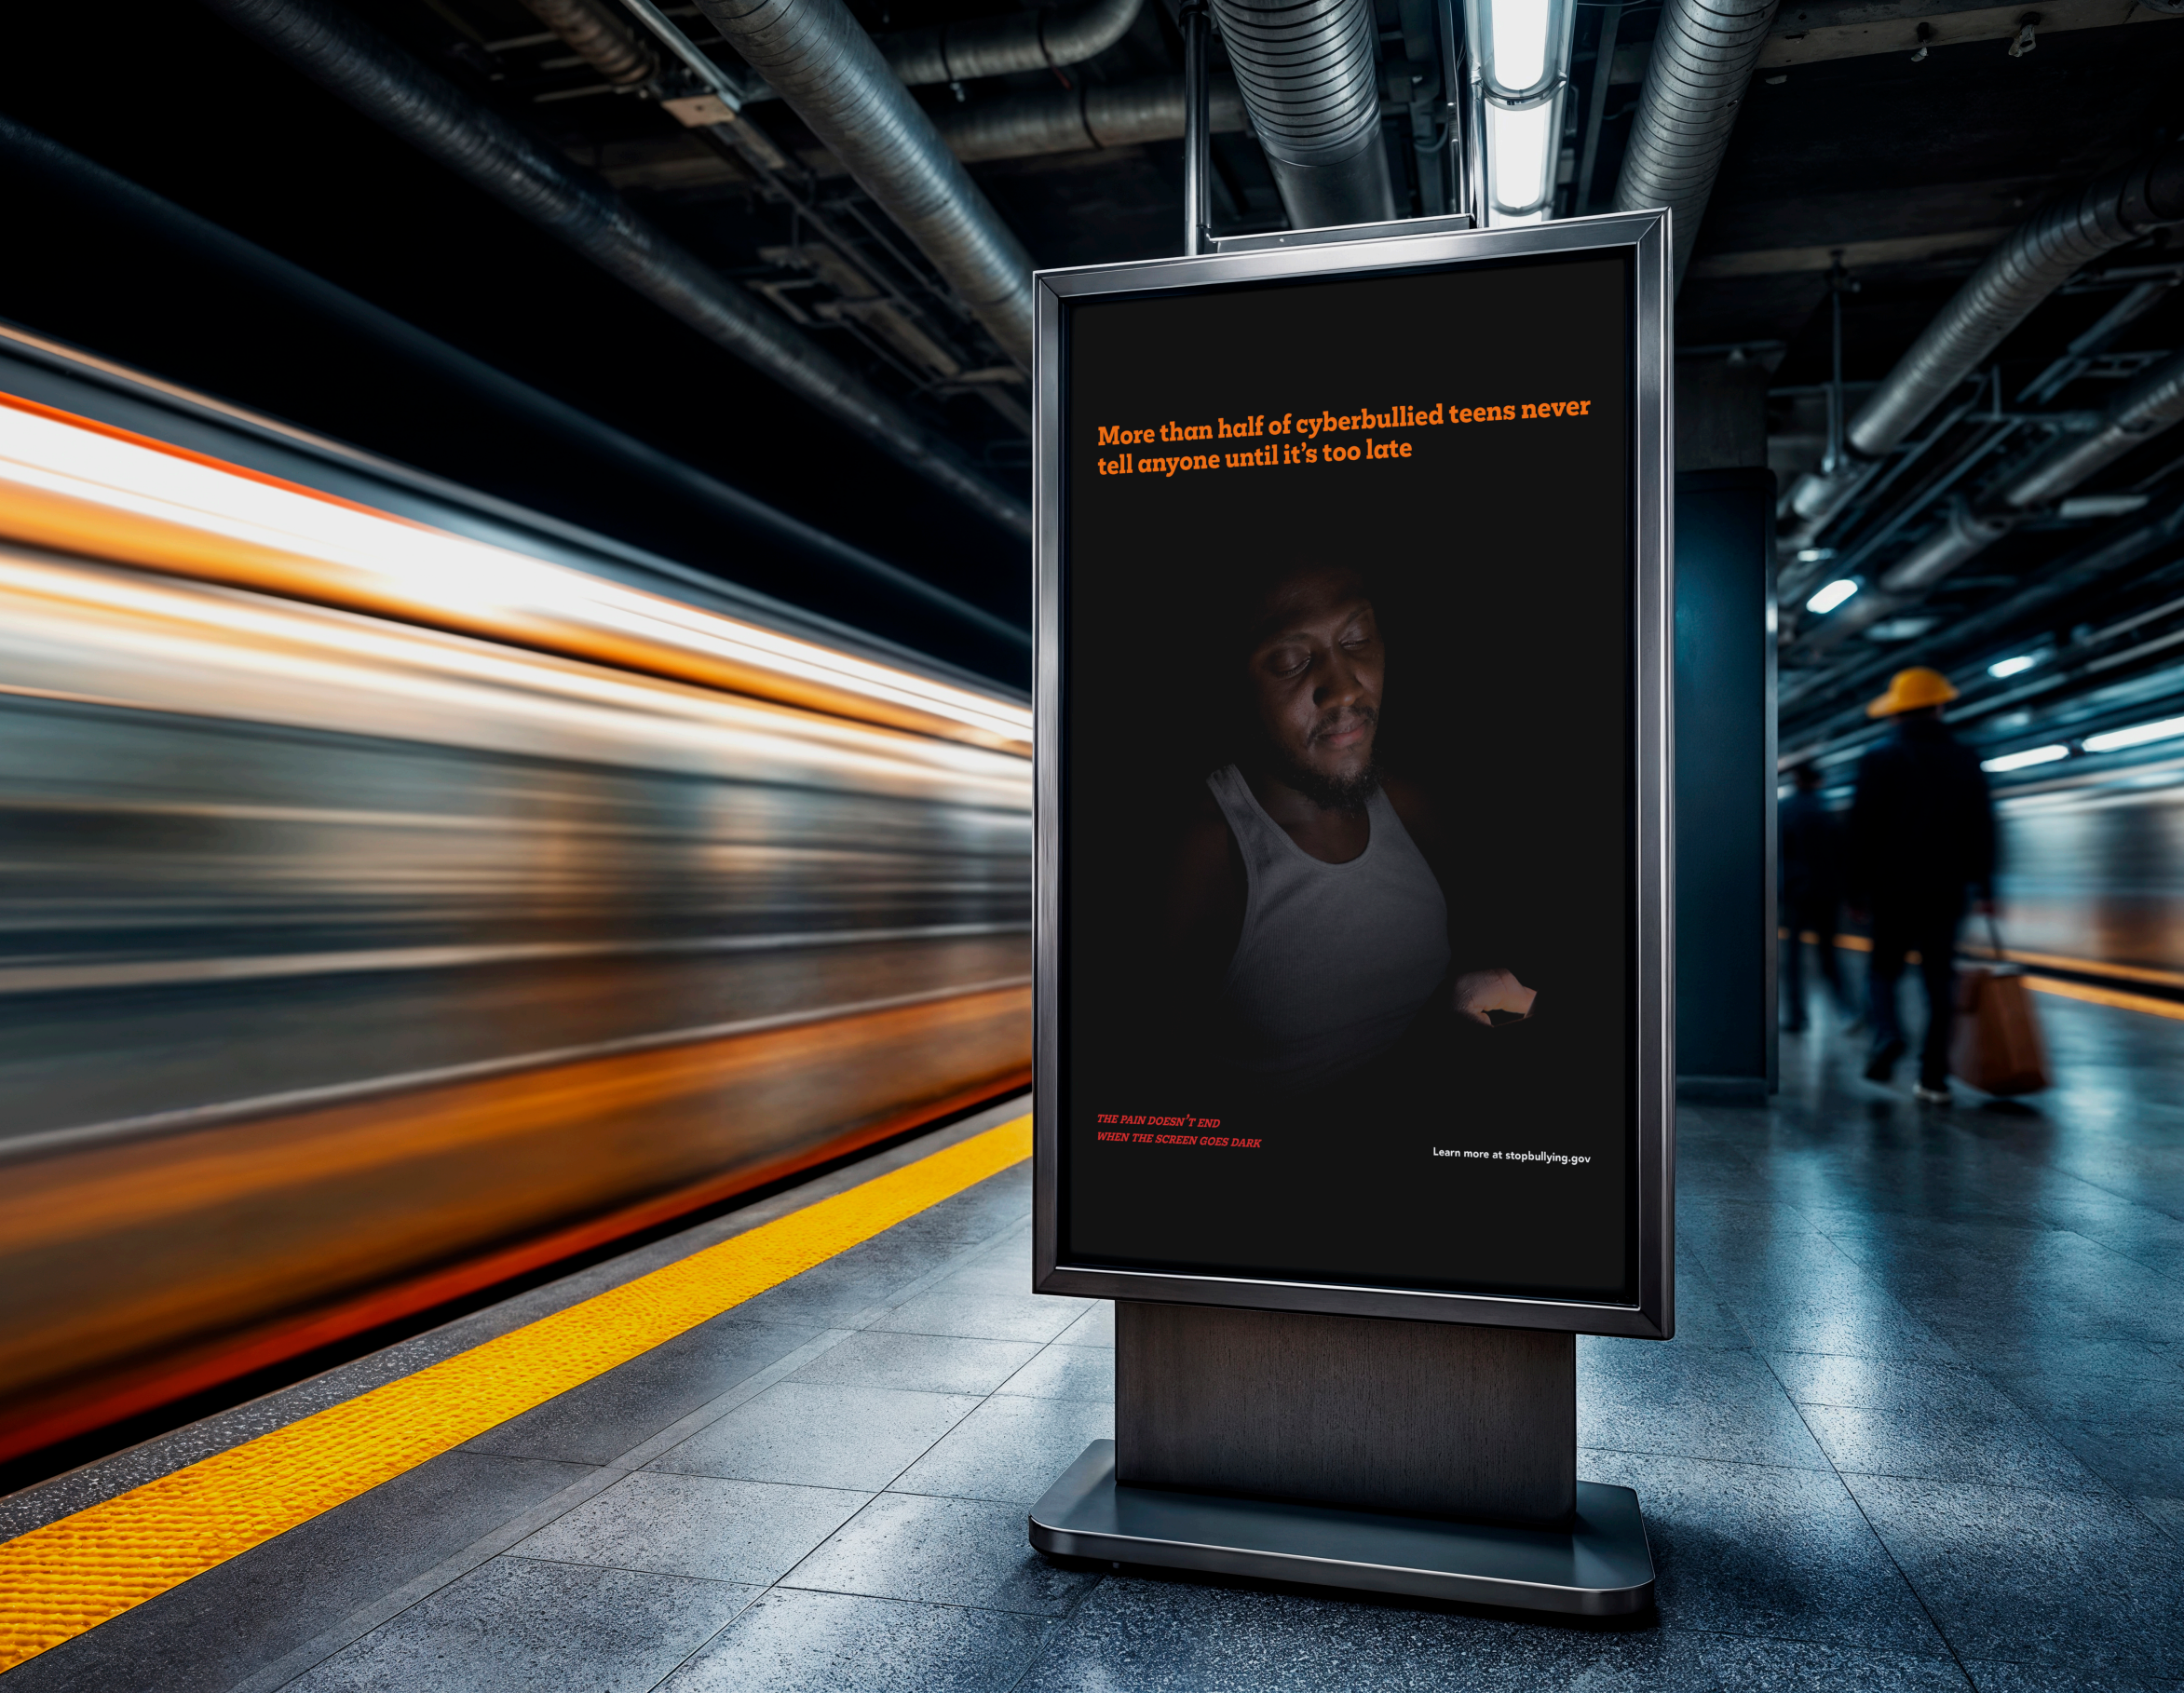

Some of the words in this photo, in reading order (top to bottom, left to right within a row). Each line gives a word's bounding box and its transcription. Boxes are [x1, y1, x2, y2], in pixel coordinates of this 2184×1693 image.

[1098, 426, 1155, 446] More
[1160, 421, 1213, 441] than
[1218, 415, 1264, 438] half
[1268, 413, 1292, 435] of
[1296, 403, 1444, 438] cyberbullied
[1449, 404, 1515, 424] teens
[1522, 400, 1592, 419] never
[1098, 454, 1133, 475] tell
[1138, 454, 1220, 478] anyone
[1226, 444, 1280, 467] until
[1284, 440, 1318, 465] it’s
[1323, 444, 1361, 463] too
[1366, 439, 1413, 459] late
[1097, 1114, 1119, 1124] THE
[1119, 1115, 1146, 1125] PAIN
[1147, 1114, 1196, 1127] DOESN’T
[1197, 1118, 1221, 1128] END
[1097, 1131, 1130, 1142] WHEN
[1132, 1133, 1154, 1144] THE
[1155, 1134, 1198, 1145] SCREEN
[1199, 1136, 1229, 1146] GOES
[1230, 1138, 1262, 1148] DARK
[1432, 1146, 1461, 1158] Learn
[1463, 1150, 1489, 1158] more
[1492, 1150, 1503, 1159] at
[1505, 1150, 1592, 1165] stopbullying.gov
